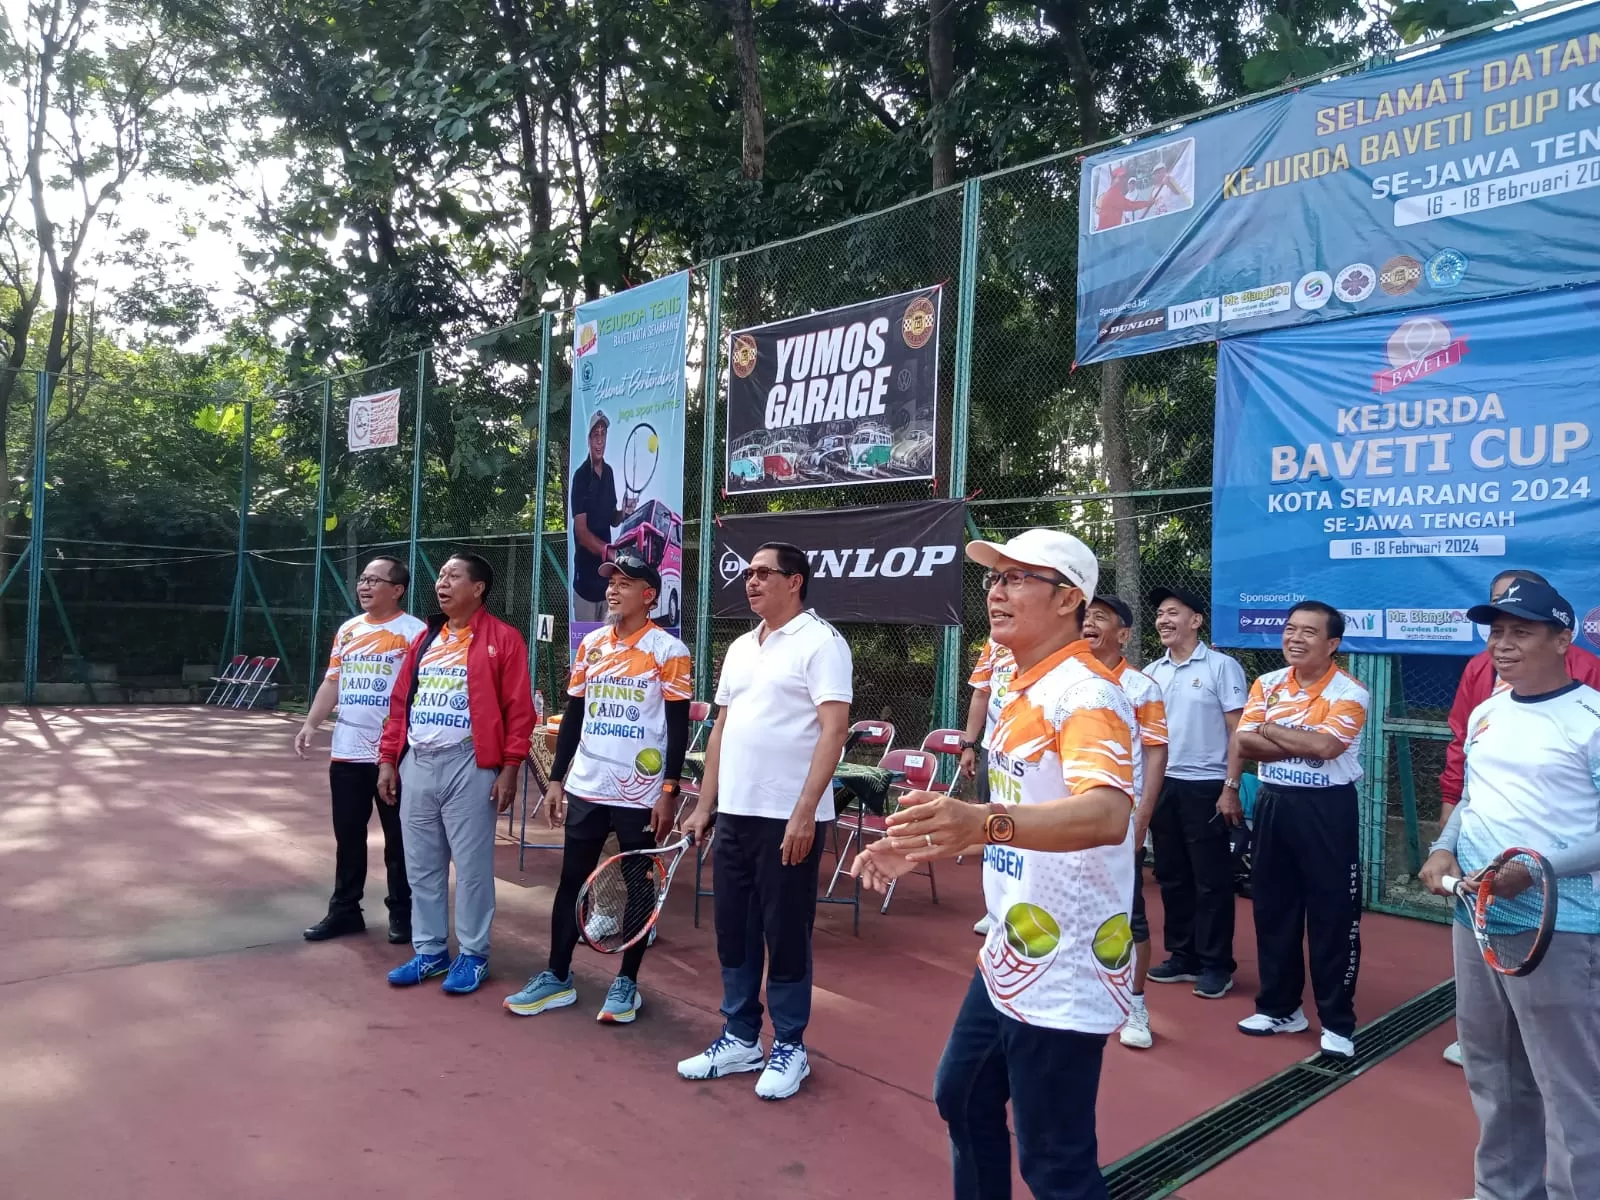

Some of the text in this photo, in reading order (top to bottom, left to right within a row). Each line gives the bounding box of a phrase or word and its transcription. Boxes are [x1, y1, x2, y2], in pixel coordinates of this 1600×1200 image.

[1316, 69, 1470, 136] SELAMAT
[1223, 142, 1350, 200] KEJURDA
[1360, 111, 1472, 166] BAVETI
[1485, 88, 1559, 137] CUP
[1371, 147, 1520, 200] SE-JAWA
[1426, 195, 1443, 217] 16
[1463, 187, 1480, 209] 18
[1488, 169, 1569, 204] Februari
[1110, 316, 1164, 334] DUNLOP
[775, 317, 890, 384] YUMOS
[1391, 351, 1451, 388] BAVETI
[764, 365, 892, 431] GARAGE
[1336, 393, 1505, 434] KEJURDA
[1270, 422, 1591, 484] BAVETI CUP
[1268, 475, 1591, 513] KOTA SEMARANG 2024
[1323, 511, 1516, 533] SE-JAWA TENGAH
[1350, 540, 1362, 556] 16
[1373, 540, 1385, 556] 18
[1388, 540, 1442, 555] Februari
[1445, 538, 1480, 554] 2024
[1239, 592, 1290, 604] Sponsored
[1388, 610, 1408, 623] Mr.
[540, 617, 549, 639] A
[385, 655, 394, 664] IS
[348, 677, 371, 690] AND
[637, 679, 649, 689] IS
[419, 692, 448, 707] AND
[597, 702, 625, 718] AND
